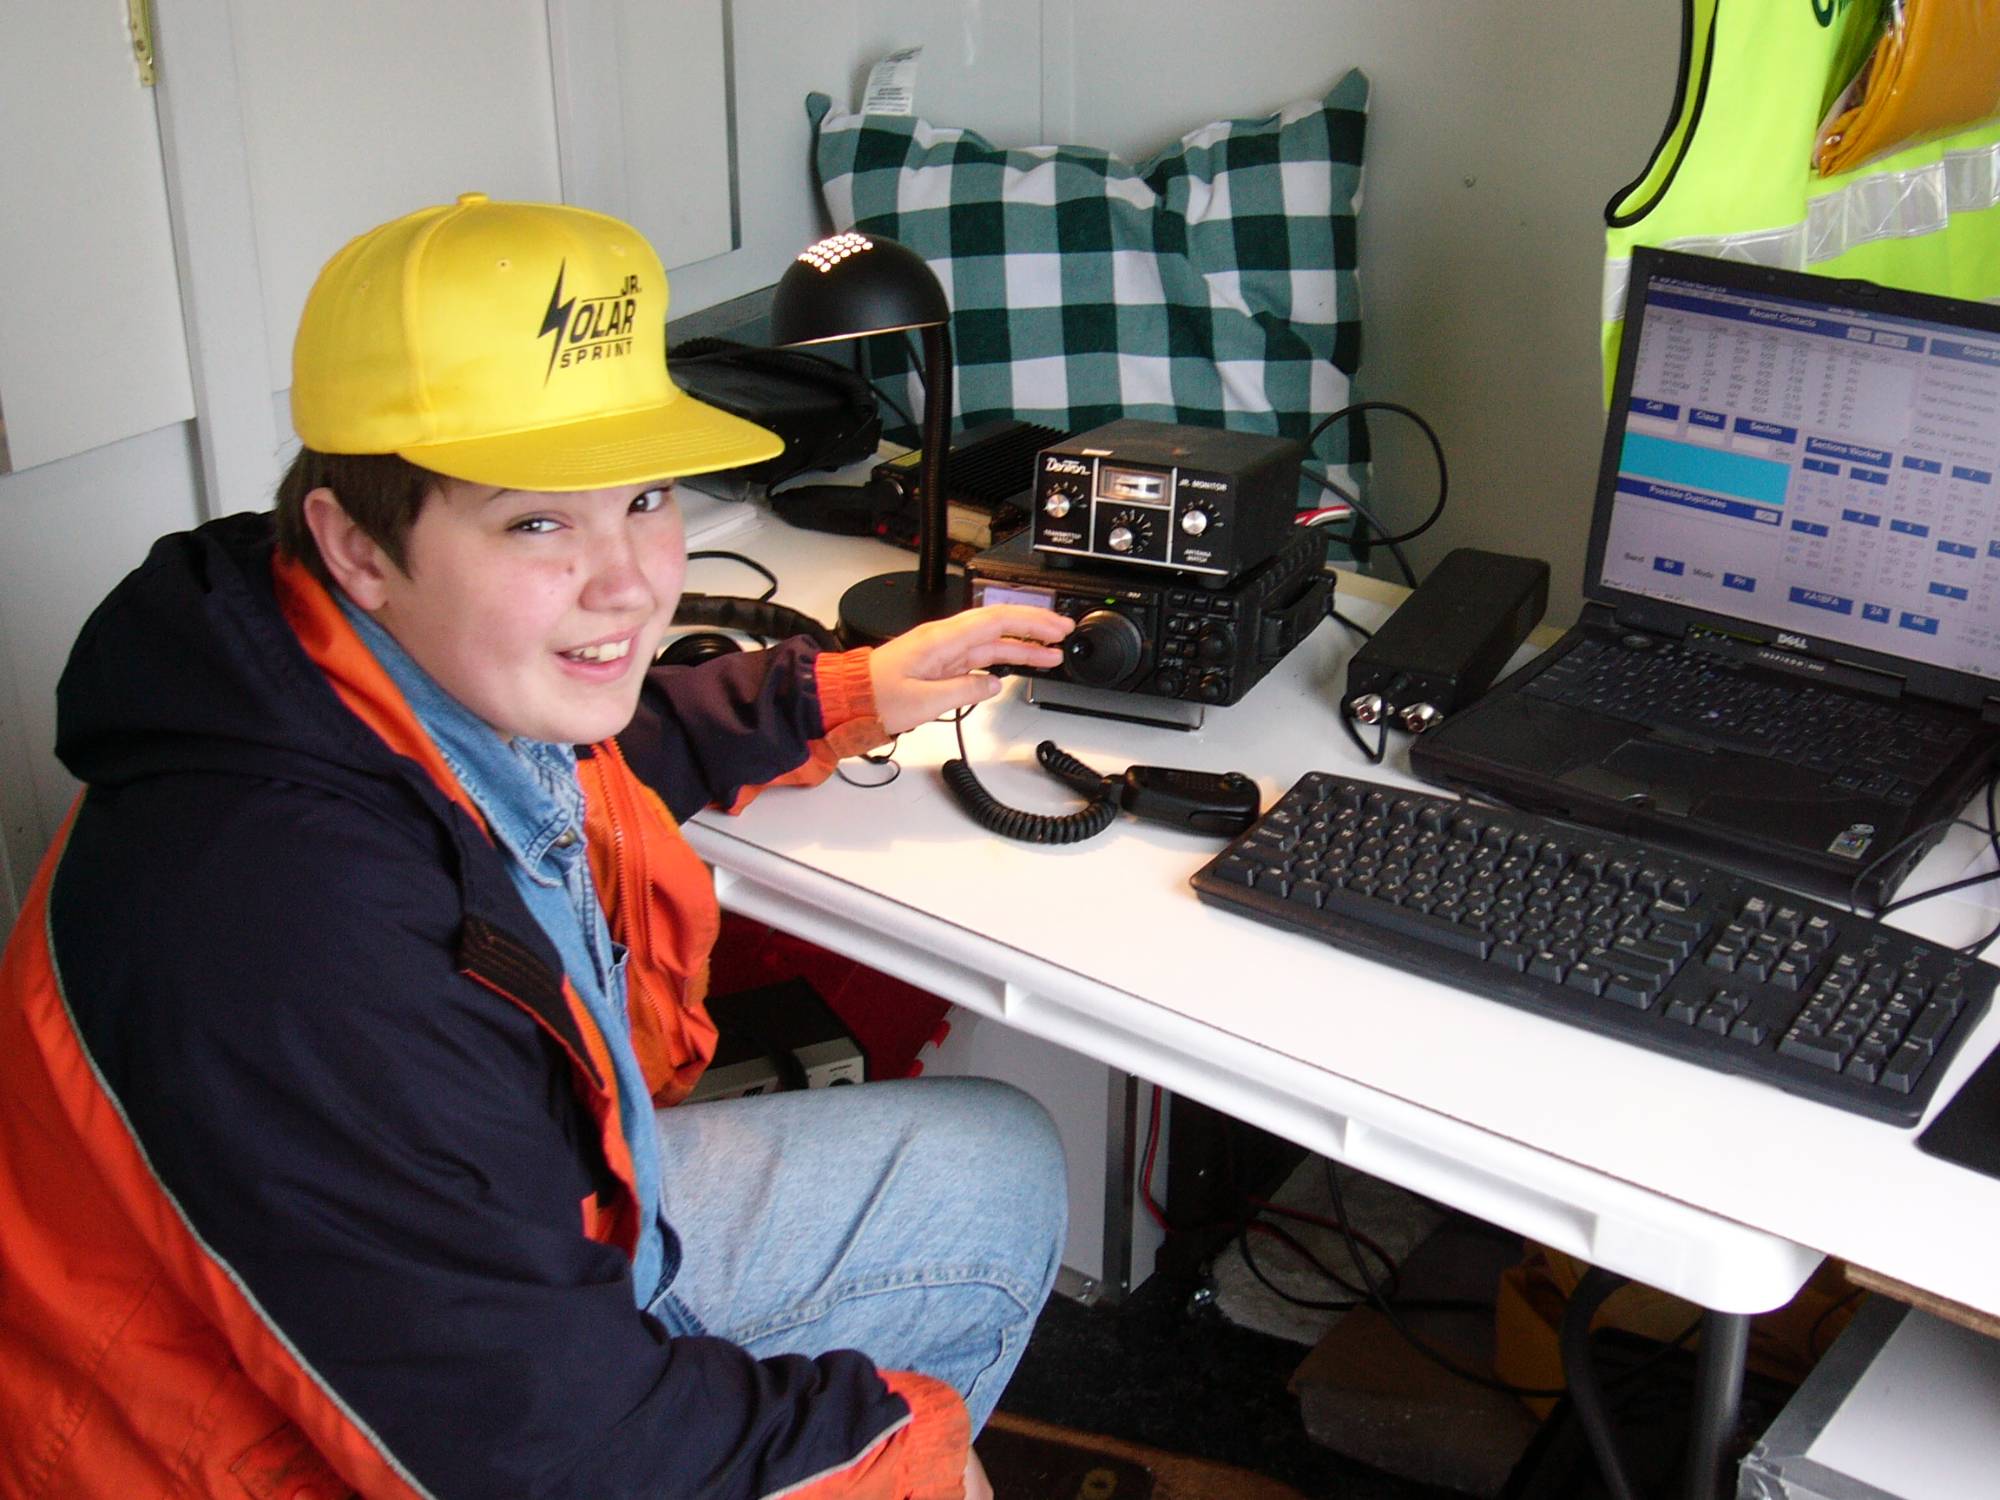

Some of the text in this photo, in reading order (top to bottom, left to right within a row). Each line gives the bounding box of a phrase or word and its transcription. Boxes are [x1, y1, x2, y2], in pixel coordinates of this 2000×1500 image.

[621, 274, 643, 296] JR.
[560, 341, 633, 369] SPRINT
[1191, 480, 1228, 491] MONITOR
[1777, 633, 1809, 650] DELL
